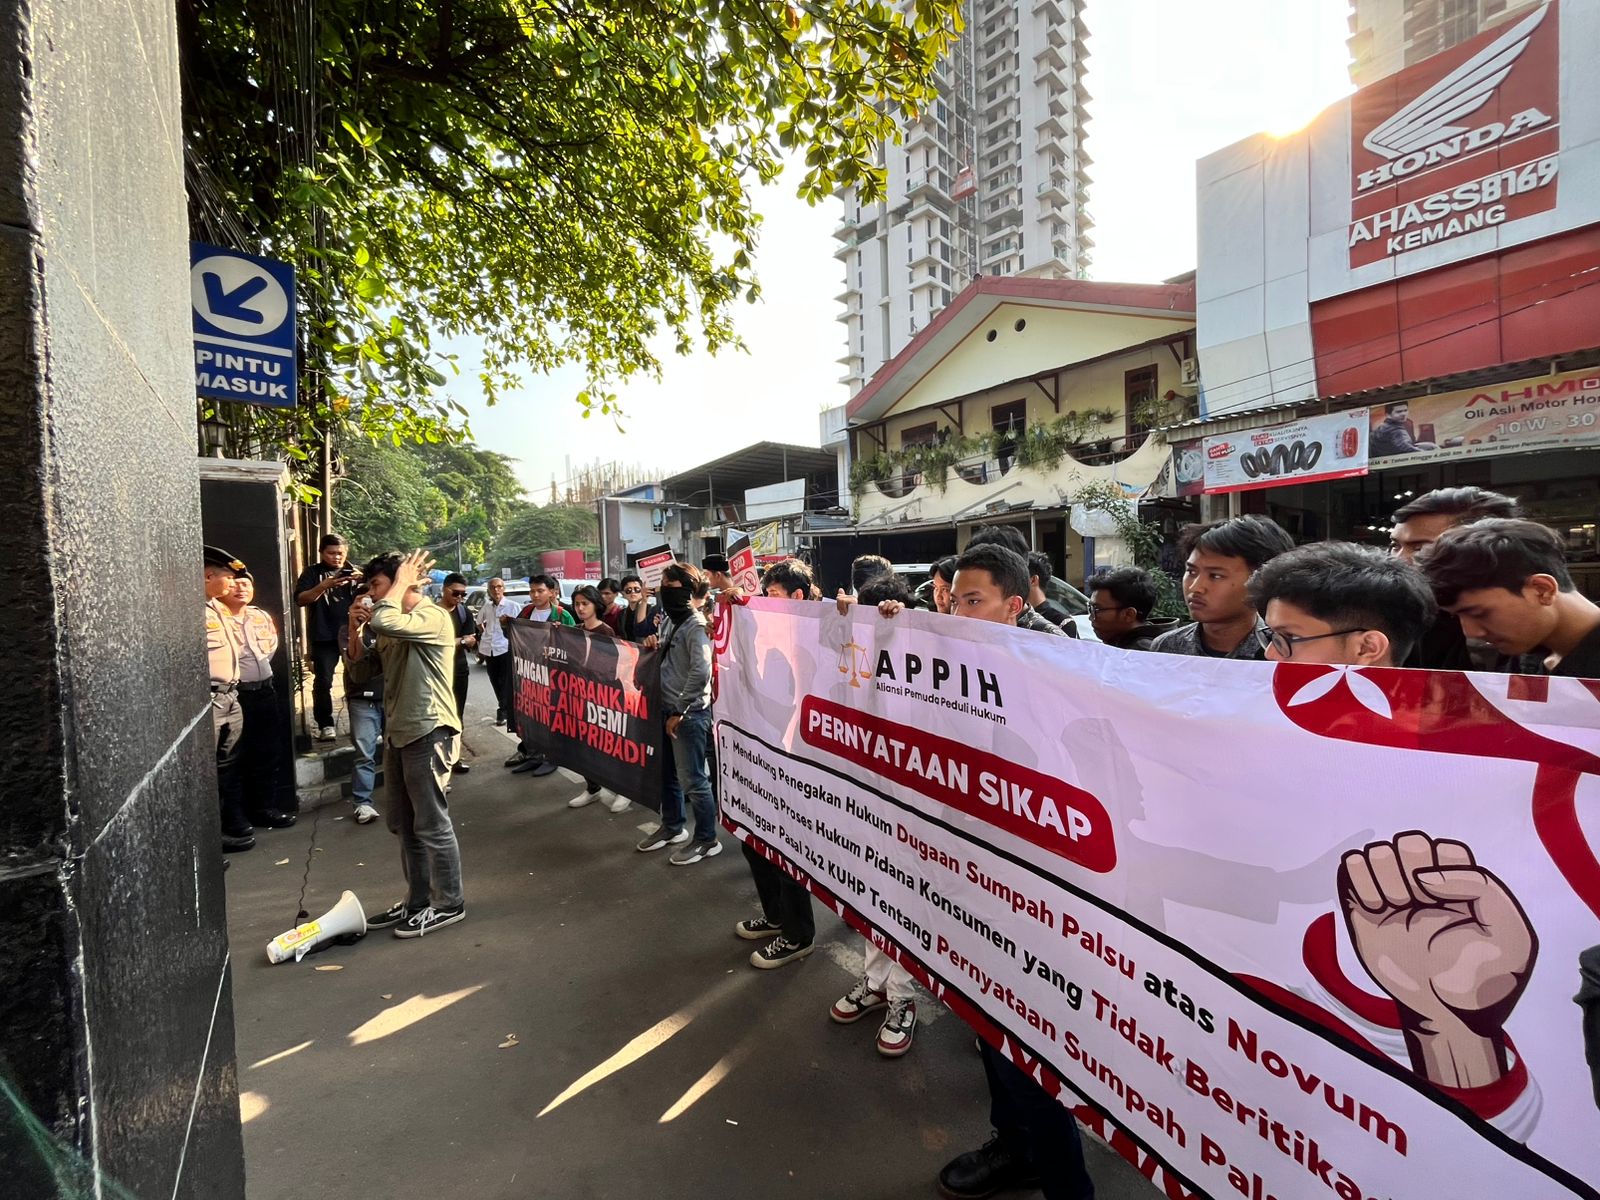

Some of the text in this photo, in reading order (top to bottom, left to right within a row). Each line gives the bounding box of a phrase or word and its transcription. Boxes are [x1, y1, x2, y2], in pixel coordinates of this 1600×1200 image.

[1357, 107, 1551, 191] HONDA
[1387, 204, 1506, 254] KEMANG
[195, 372, 288, 399] MASUK
[196, 349, 281, 377] PINTU
[1465, 408, 1484, 420] Oli
[1489, 405, 1516, 416] Asli
[1521, 398, 1567, 412] Motor
[1497, 422, 1521, 436] 10
[1526, 416, 1548, 431] W
[1567, 412, 1596, 428] 30
[876, 649, 1003, 708] APPIH
[876, 682, 1006, 725] Aliansi Pemuda Peduli Hukum
[521, 679, 550, 706] ORANG
[587, 701, 628, 737] DEMI
[808, 709, 1092, 842] PERNYATAAN SIKAP
[721, 736, 1408, 1157] 1. Mendukung Penegakan Hukum Dugaan Sumpah Palsu atas Novum
[722, 763, 1392, 1200] 2. Mendukung Proses Hukum Pidana Konsumen yang Tidak Beritika
[731, 795, 776, 833] Melanggar
[779, 825, 803, 855] Pasal
[804, 845, 825, 871] 242
[828, 860, 866, 896] KUHP
[869, 887, 932, 952] Tentang
[937, 934, 1056, 1042] Pernyataan
[1064, 1030, 1186, 1149] Sumpah
[1201, 1133, 1279, 1200] Pal
